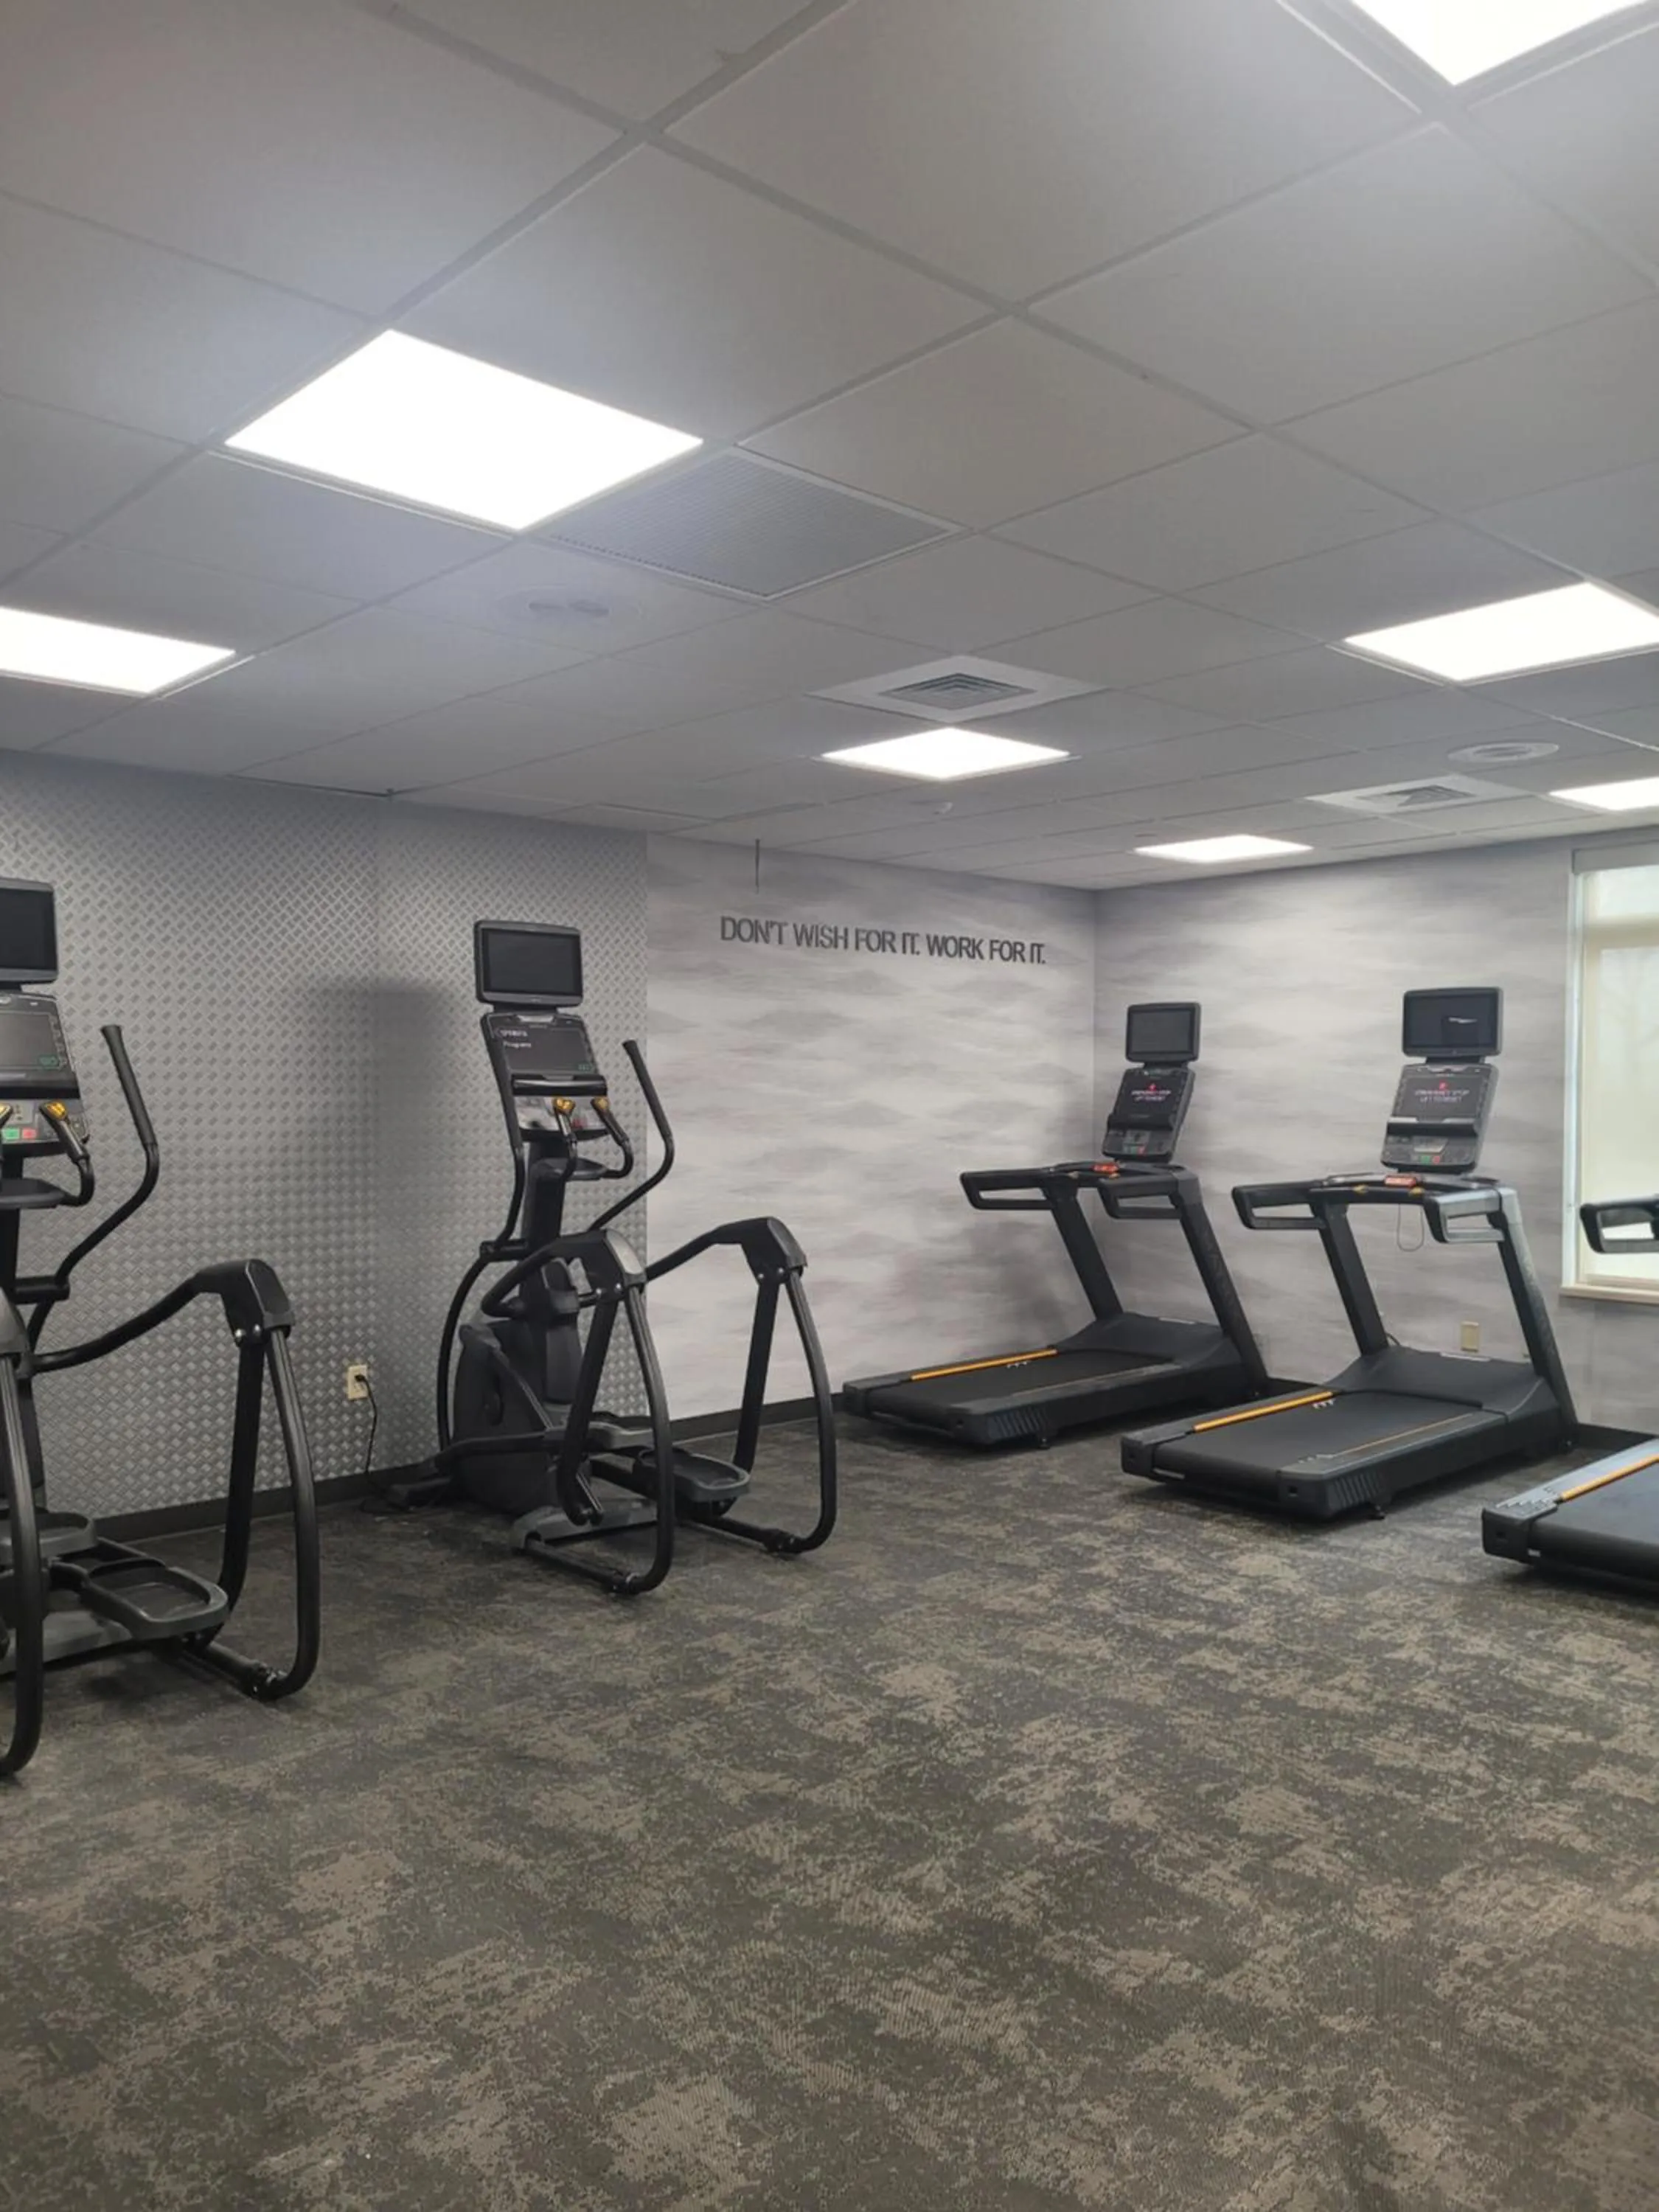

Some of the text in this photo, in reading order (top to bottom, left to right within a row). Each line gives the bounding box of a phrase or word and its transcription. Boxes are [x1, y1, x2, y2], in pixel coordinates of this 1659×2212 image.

[720, 916, 1046, 964] DON'T WISH FOR IT. WORK FOR IT.
